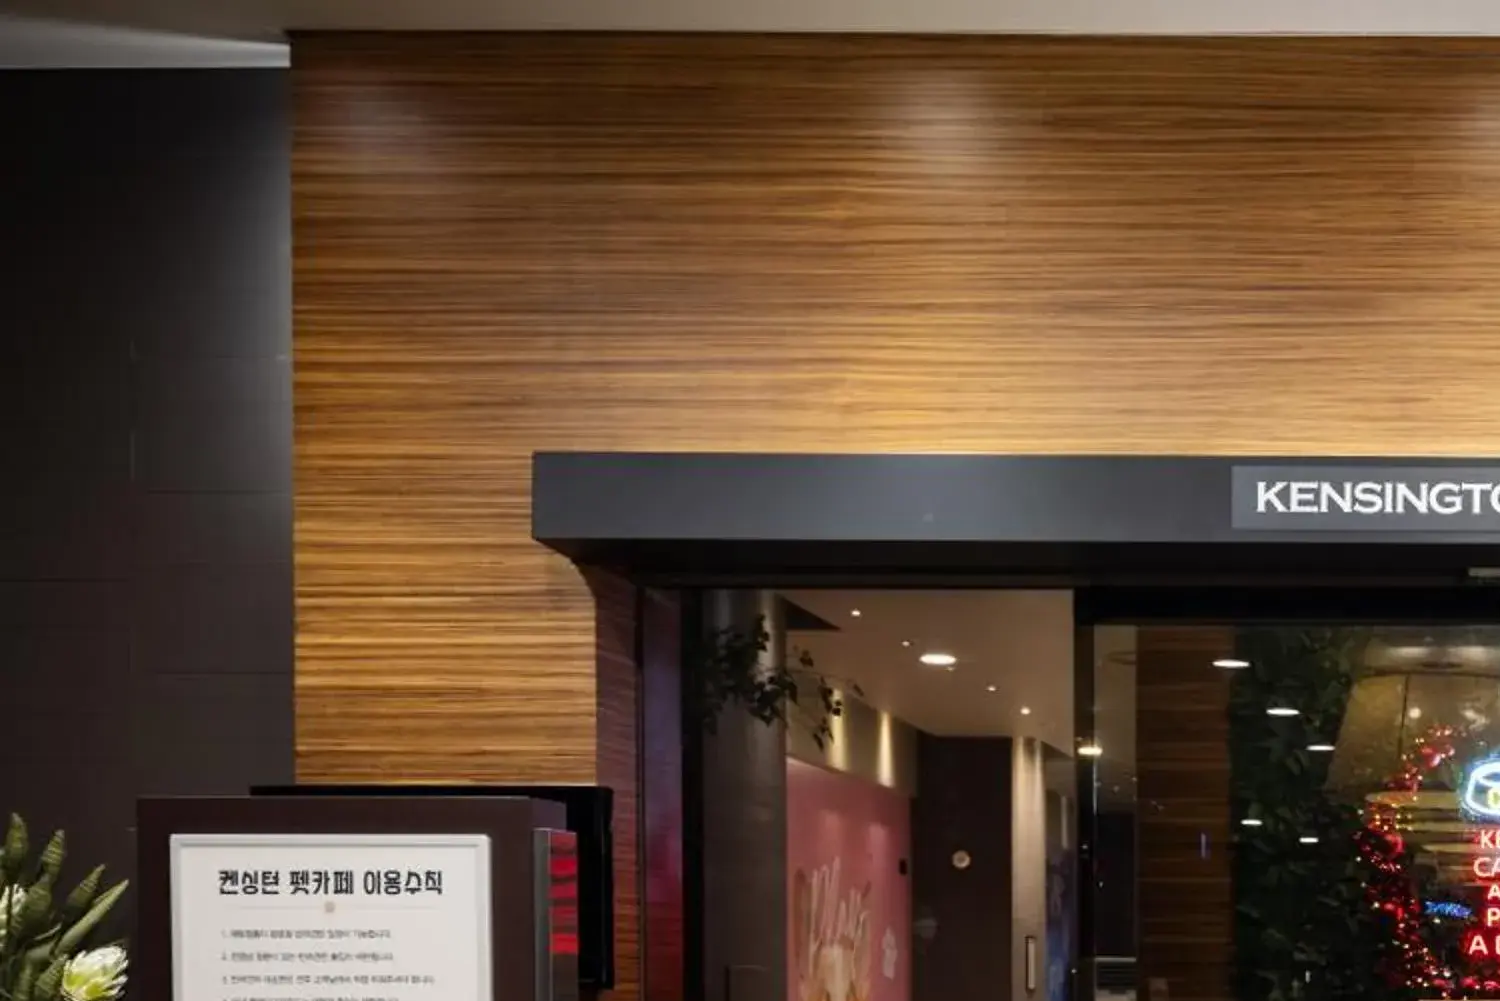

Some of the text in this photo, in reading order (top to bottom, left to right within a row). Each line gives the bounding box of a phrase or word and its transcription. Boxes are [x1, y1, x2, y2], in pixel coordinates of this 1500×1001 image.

[218, 870, 443, 895] 켄싱턴 펫카페 이용수칙
[1469, 936, 1488, 954] A
